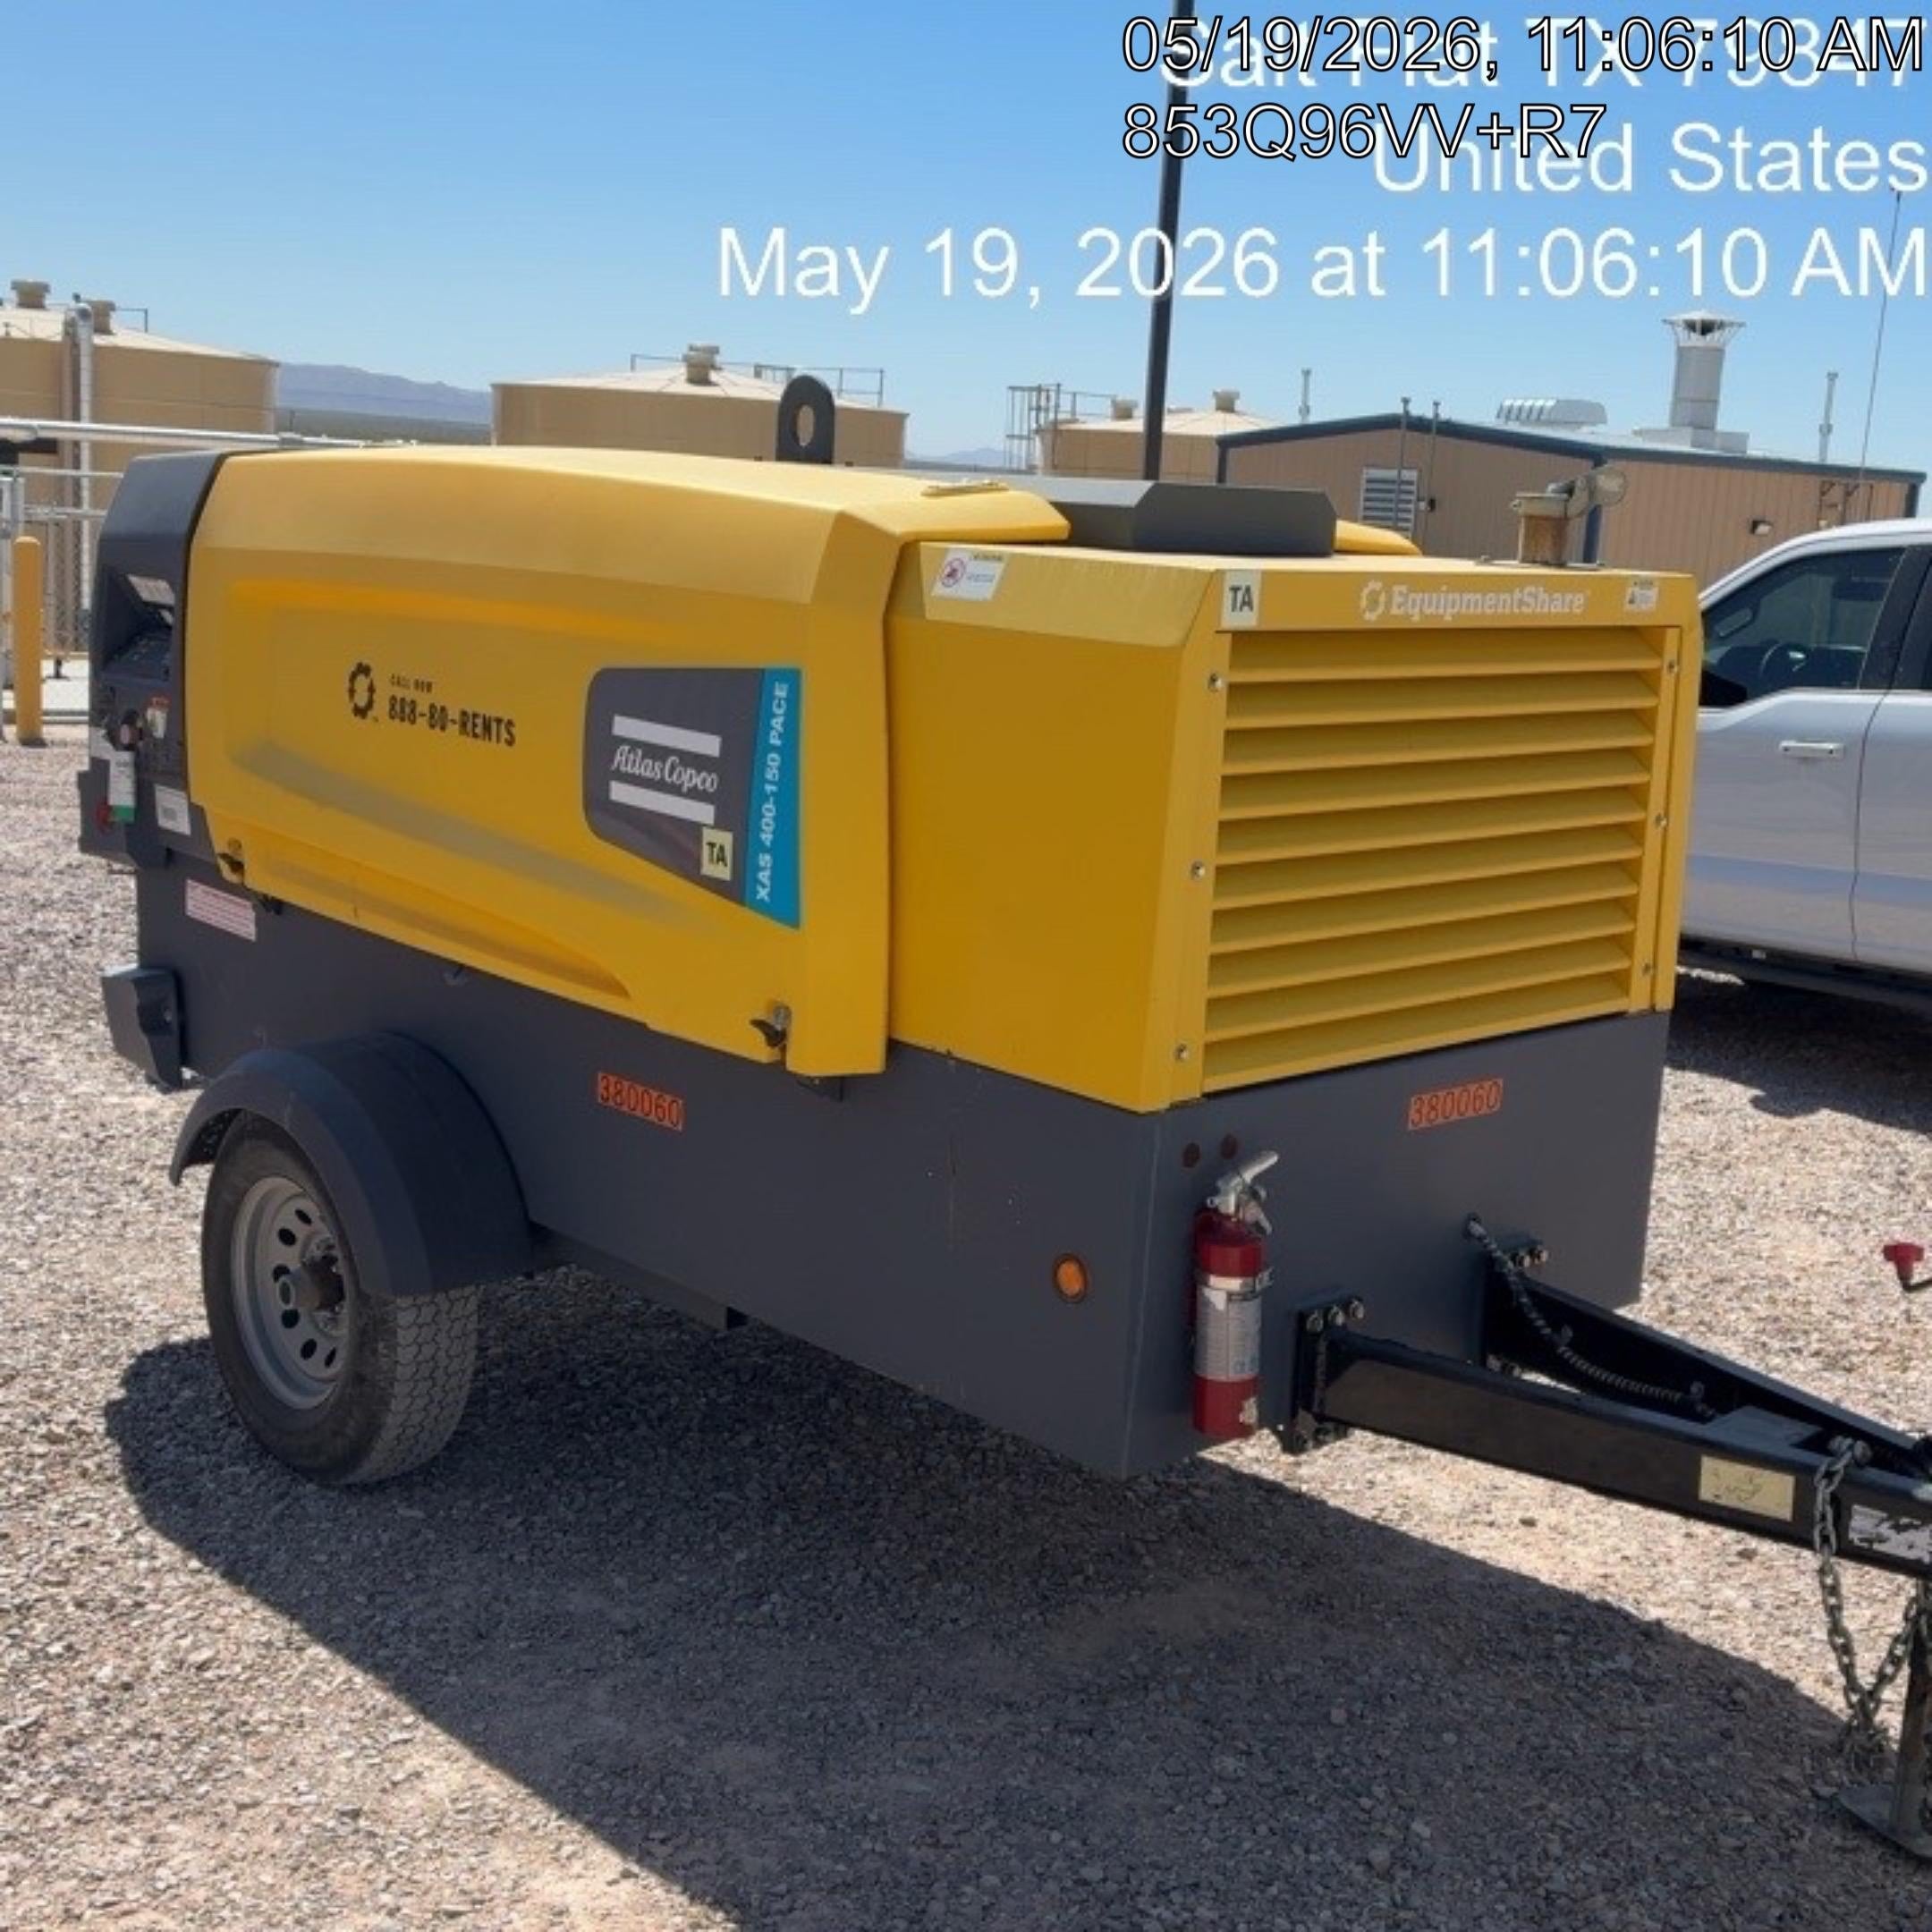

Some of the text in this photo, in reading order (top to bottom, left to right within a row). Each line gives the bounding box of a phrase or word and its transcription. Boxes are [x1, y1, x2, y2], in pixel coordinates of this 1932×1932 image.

[1229, 585, 1254, 613] TA
[1390, 584, 1586, 621] EquipmentShare
[388, 694, 516, 747] 888-80-RENTS
[610, 744, 719, 792] Atlas Copco
[756, 681, 789, 902] XAS 400-150 PACE
[707, 842, 728, 867] TA
[600, 1075, 679, 1127] 380060
[1411, 1080, 1502, 1127] 380060
